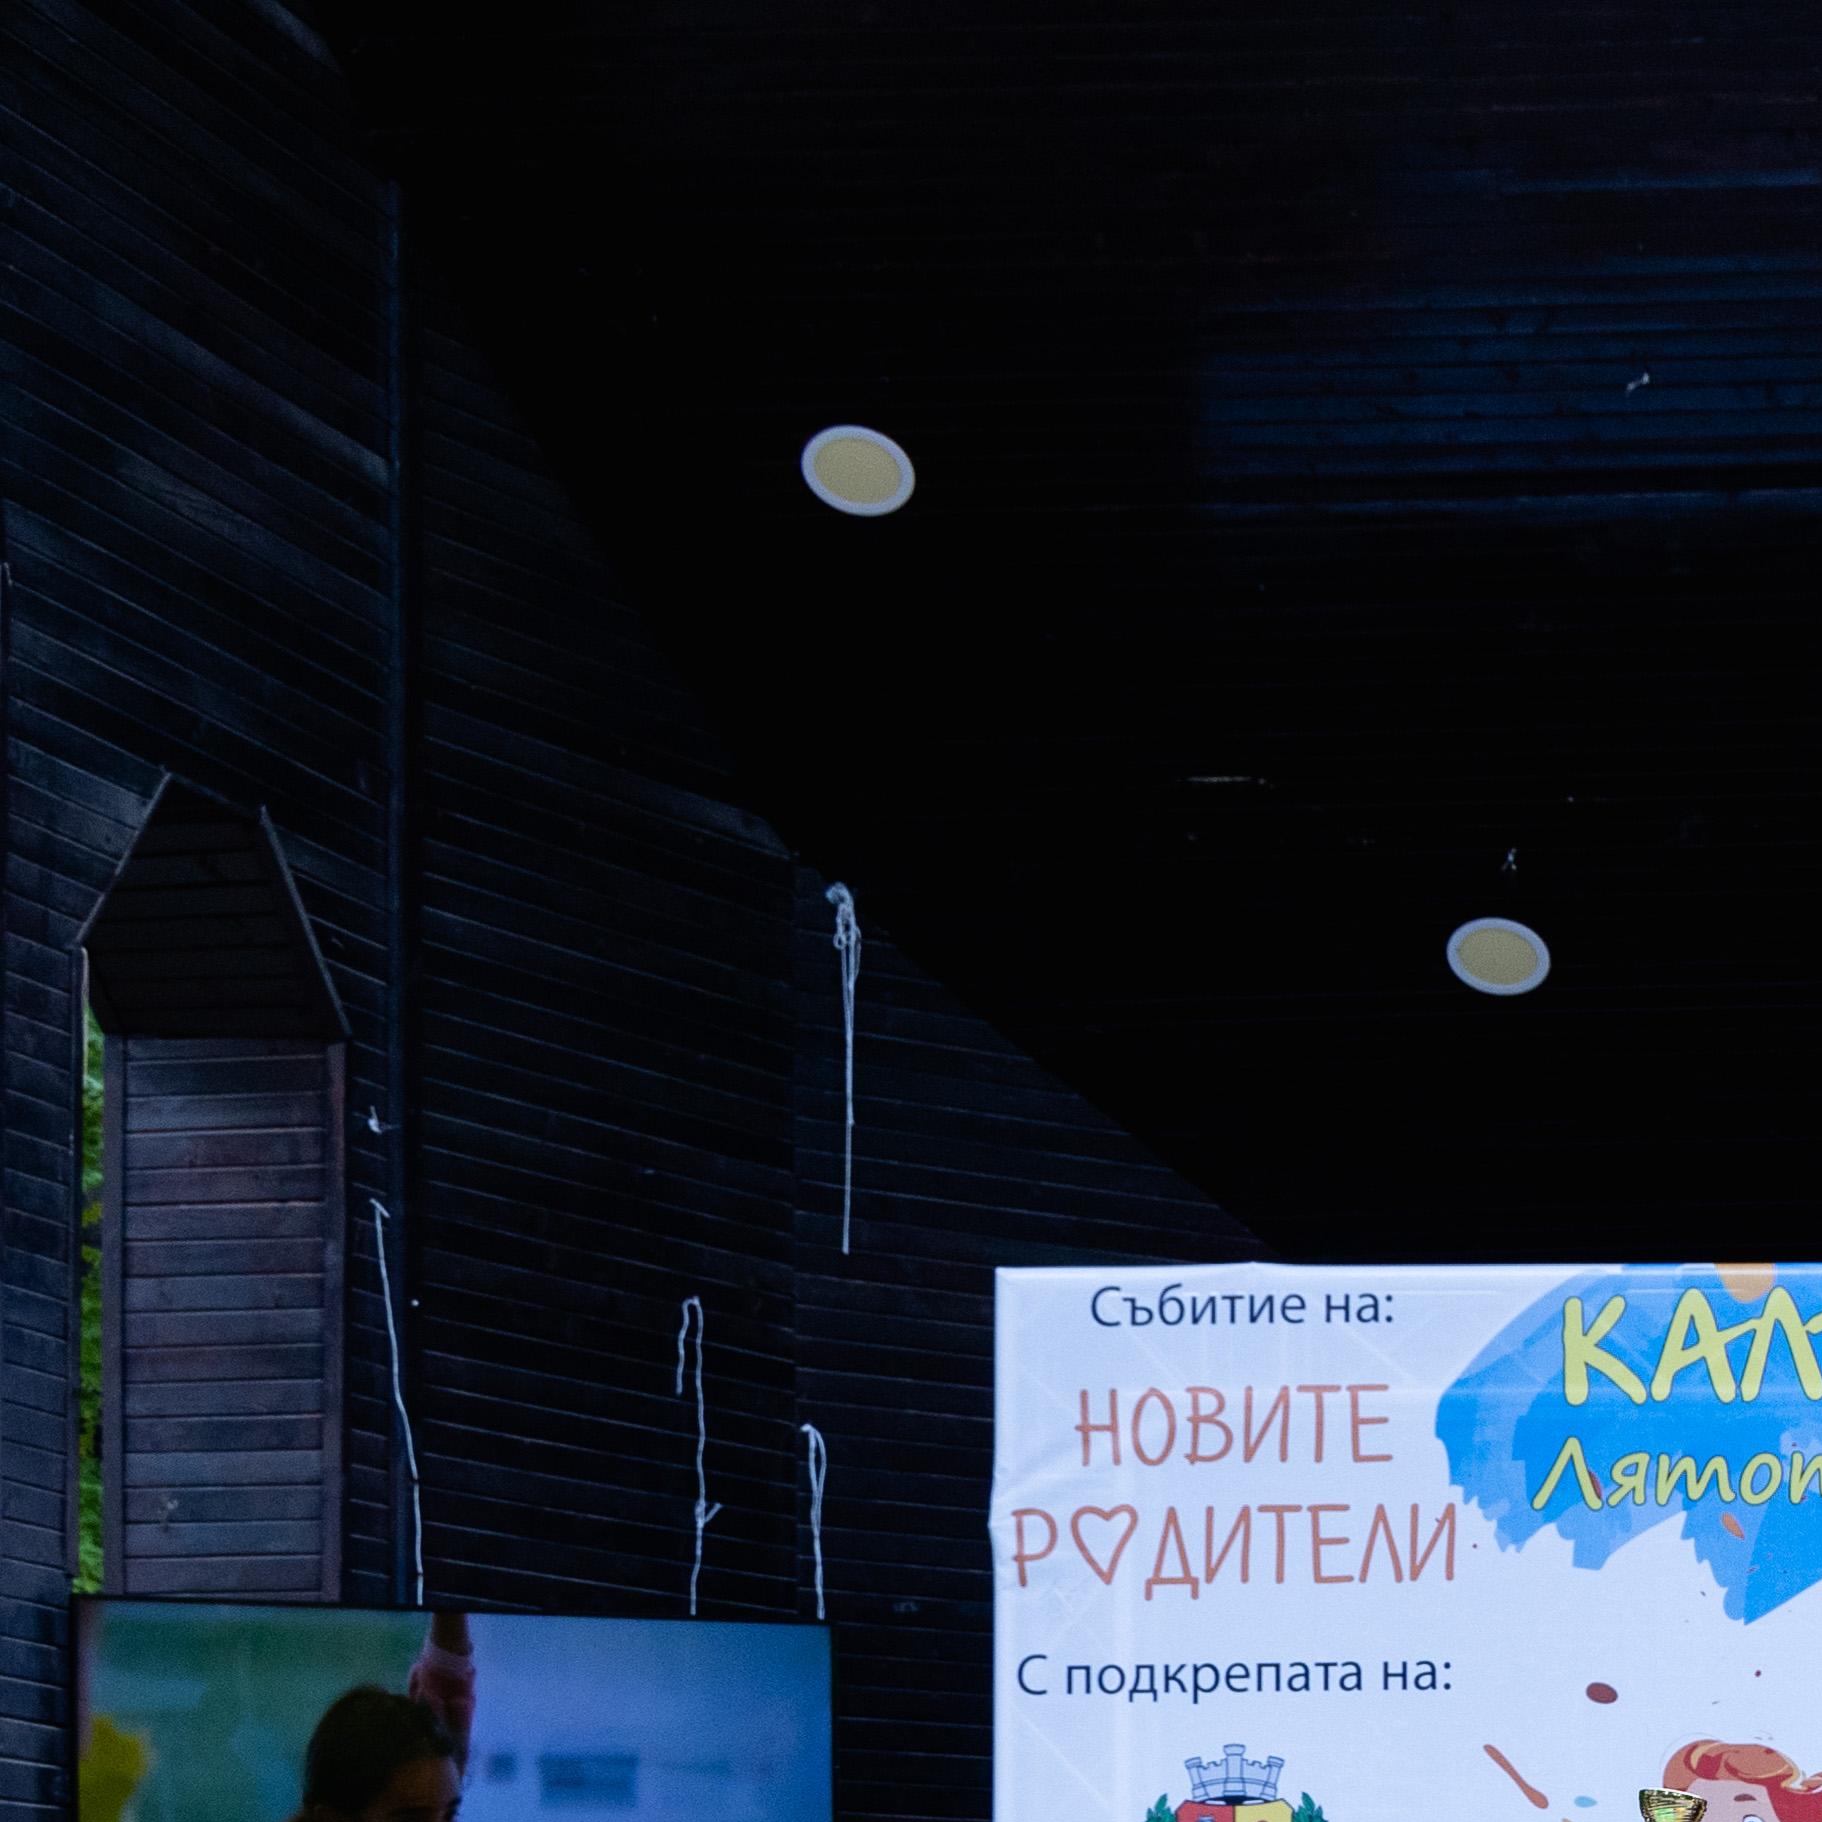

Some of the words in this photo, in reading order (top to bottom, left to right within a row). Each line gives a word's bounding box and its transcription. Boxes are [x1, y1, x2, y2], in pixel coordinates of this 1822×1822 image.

[1090, 1283, 1306, 1328] Събитие
[1324, 1291, 1394, 1324] на:
[1074, 1382, 1395, 1467] НОВИТЕ
[1016, 1654, 1048, 1696] С
[1065, 1660, 1363, 1705] подкрепата
[1382, 1657, 1452, 1693] на:
